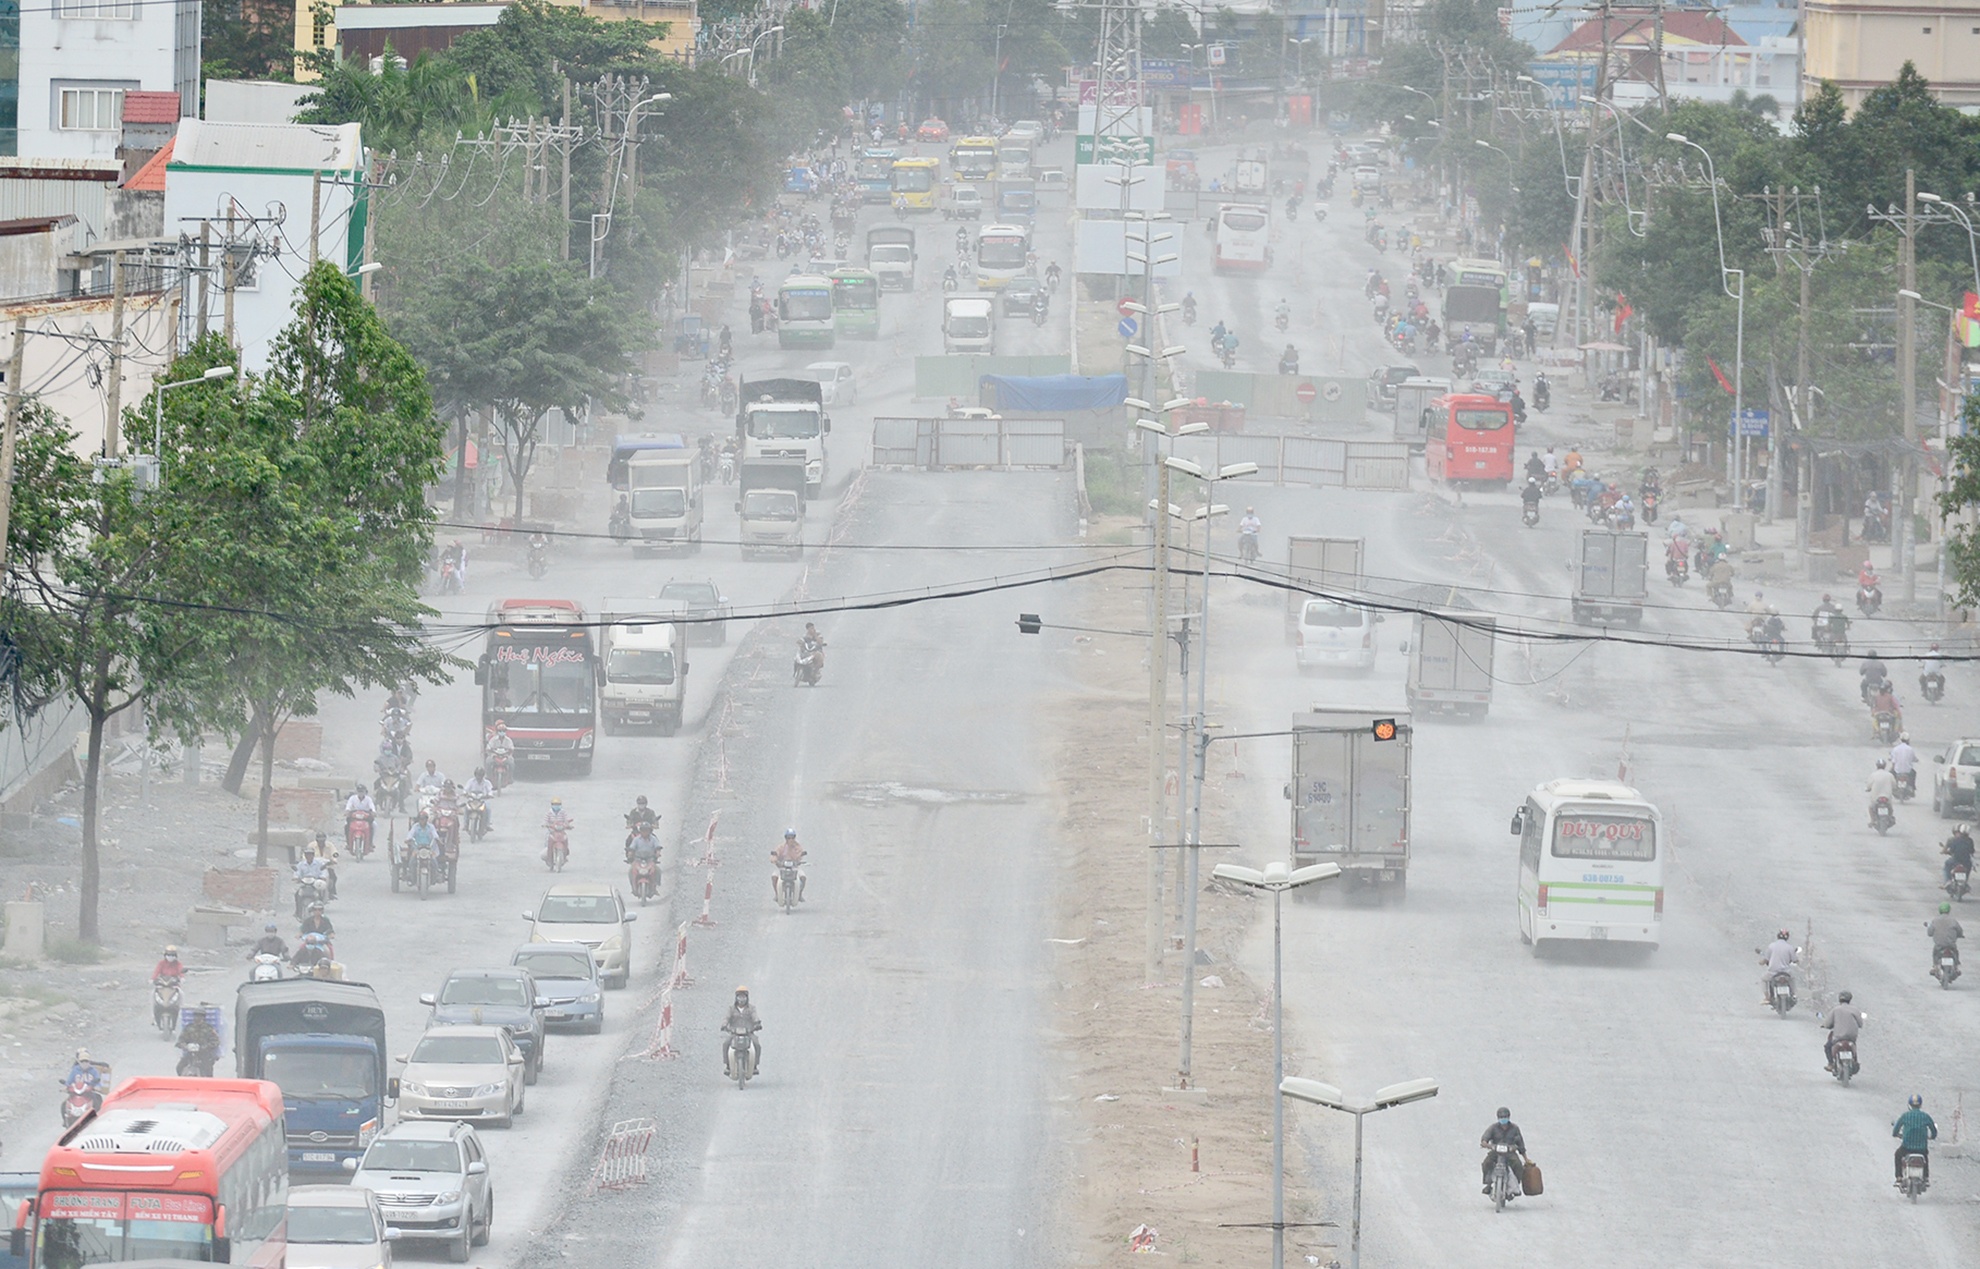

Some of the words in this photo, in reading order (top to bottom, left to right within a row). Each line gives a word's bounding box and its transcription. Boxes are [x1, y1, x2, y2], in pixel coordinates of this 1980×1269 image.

[497, 646, 530, 665] Huệ
[532, 646, 585, 668] Nghĩa
[1561, 821, 1602, 838] DUY
[1604, 820, 1646, 842] QUÝ
[90, 1197, 120, 1208] TRANG
[130, 1197, 162, 1209] FUTA
[164, 1198, 182, 1210] Bus
[183, 1199, 207, 1212] Lines
